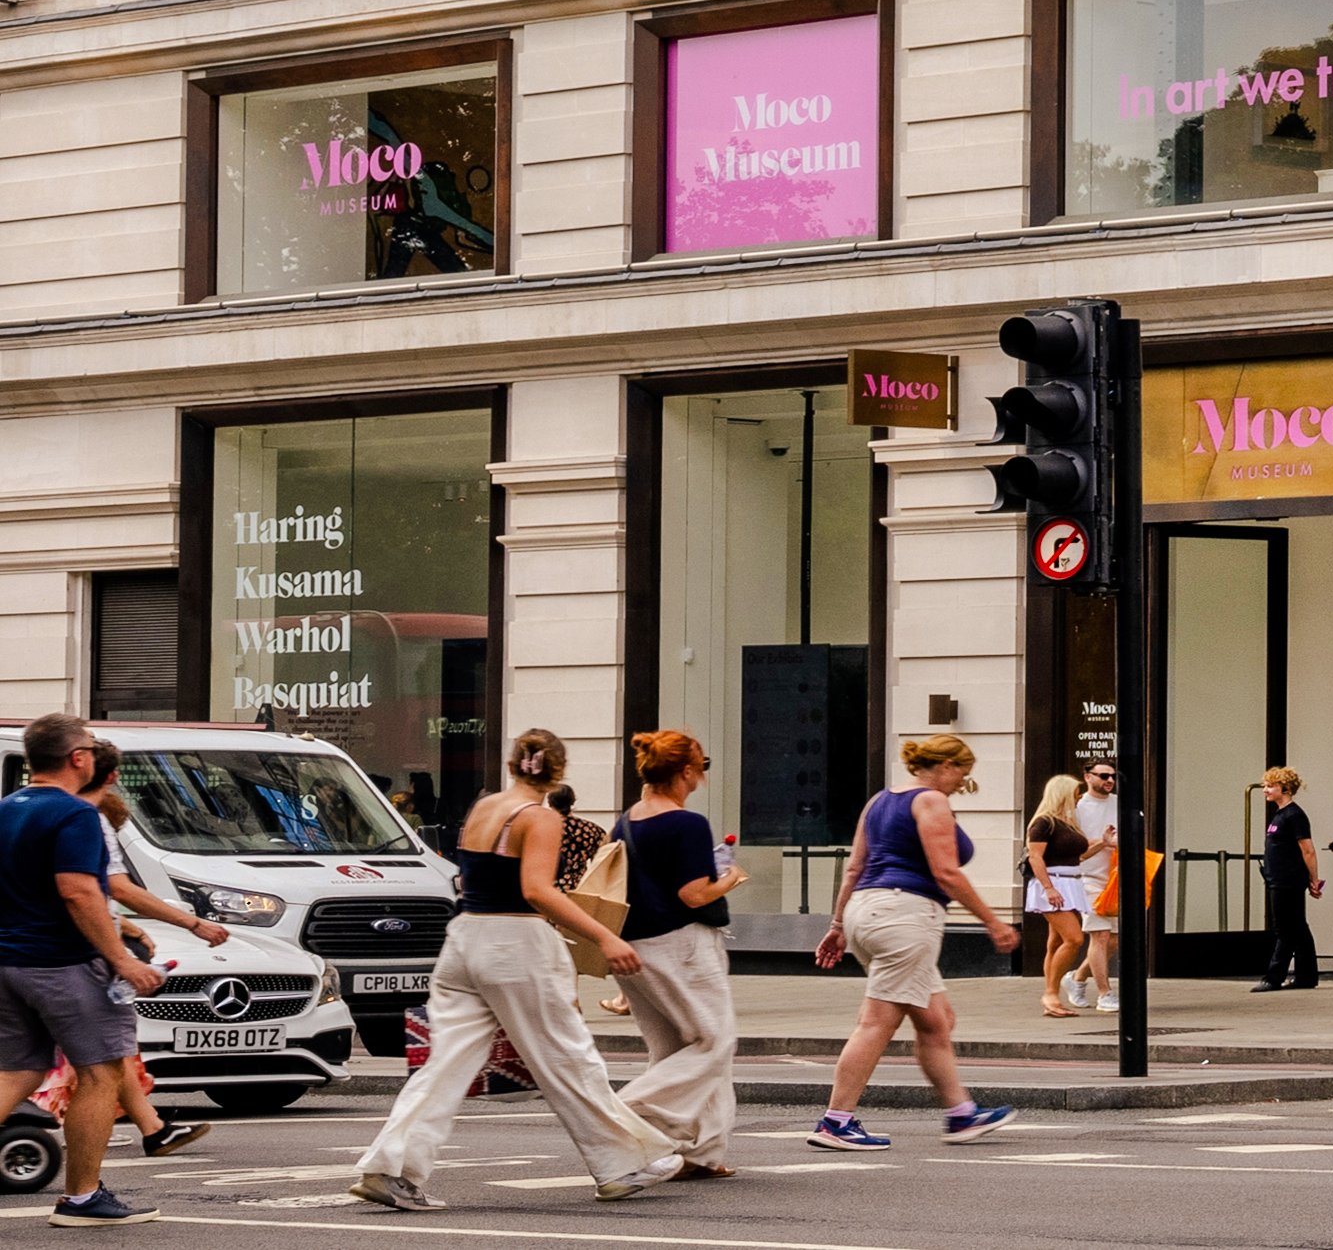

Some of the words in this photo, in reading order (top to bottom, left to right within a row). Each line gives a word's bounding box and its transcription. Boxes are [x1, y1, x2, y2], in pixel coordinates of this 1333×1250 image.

[1119, 73, 1155, 119] In
[1166, 68, 1229, 114] art
[1239, 68, 1305, 106] we
[731, 92, 833, 133] Moco
[300, 140, 422, 190] Moco
[702, 140, 863, 185] Museum
[319, 194, 397, 216] MUSEUM
[862, 373, 939, 401] Moco
[1231, 463, 1313, 480] MUSEUM
[233, 505, 344, 549] Haring
[234, 566, 364, 599] Kusama
[234, 613, 351, 654] Warhol
[233, 671, 372, 718] Basquiat
[1082, 701, 1117, 715] Moco
[1078, 732, 1097, 740] OPEN
[1088, 741, 1108, 749] FROM
[1075, 750, 1090, 758] 9AM
[383, 920, 405, 930] Ford
[364, 975, 398, 991] CP18
[401, 975, 430, 990] LXR
[186, 1030, 240, 1048] DX68
